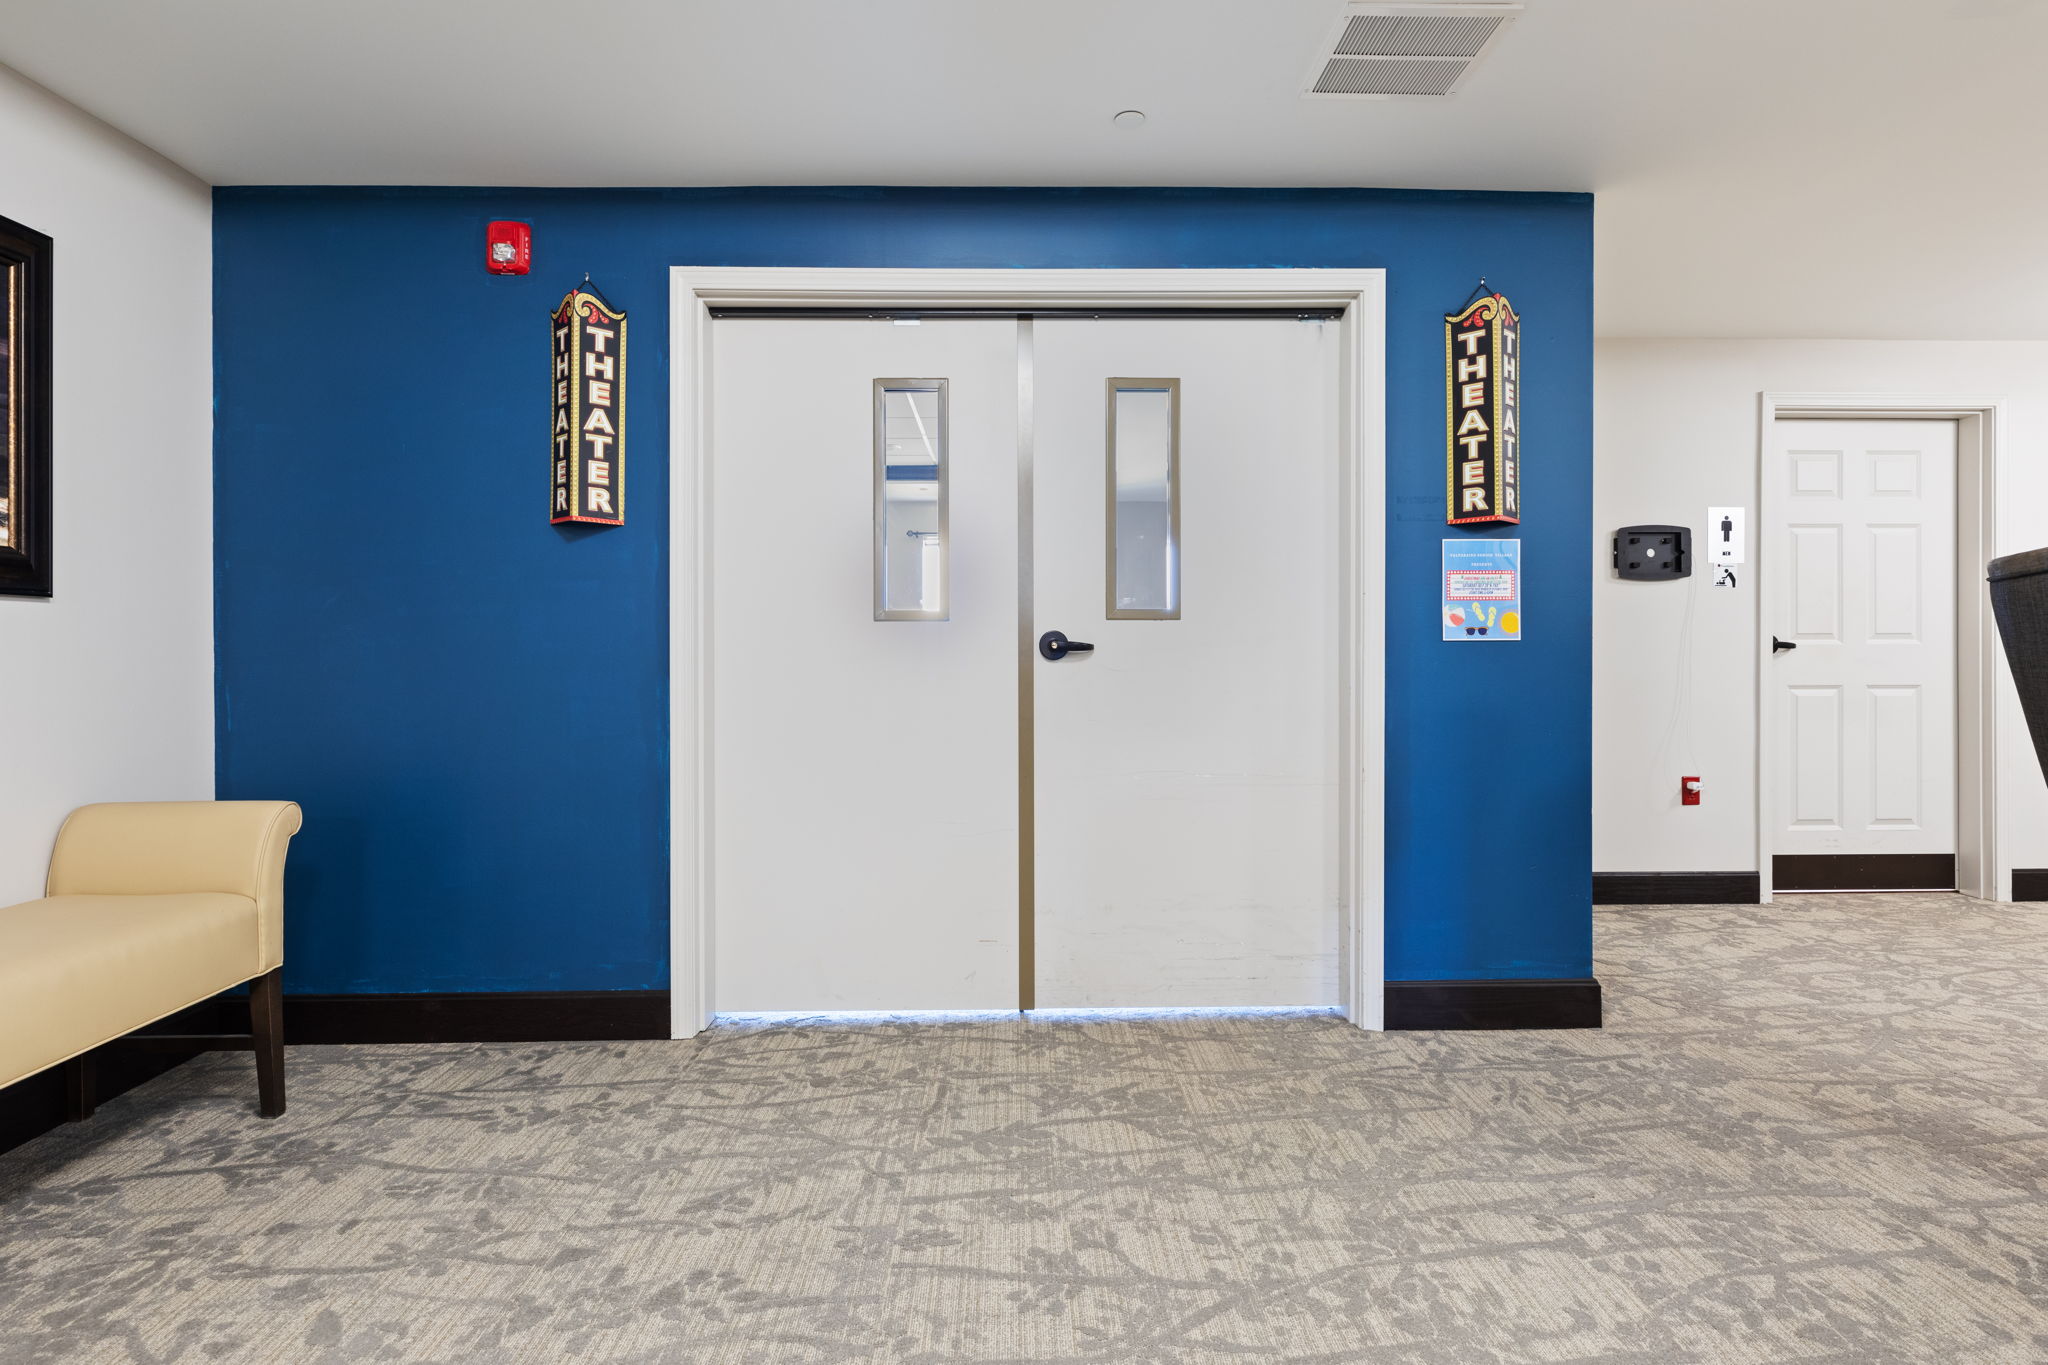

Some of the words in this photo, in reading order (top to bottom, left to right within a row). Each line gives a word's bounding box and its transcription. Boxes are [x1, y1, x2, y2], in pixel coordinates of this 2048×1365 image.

[555, 325, 569, 512] THEATER
[583, 325, 615, 514] THEATER
[1457, 328, 1489, 512] THEATER
[1503, 328, 1516, 512] THEATER
